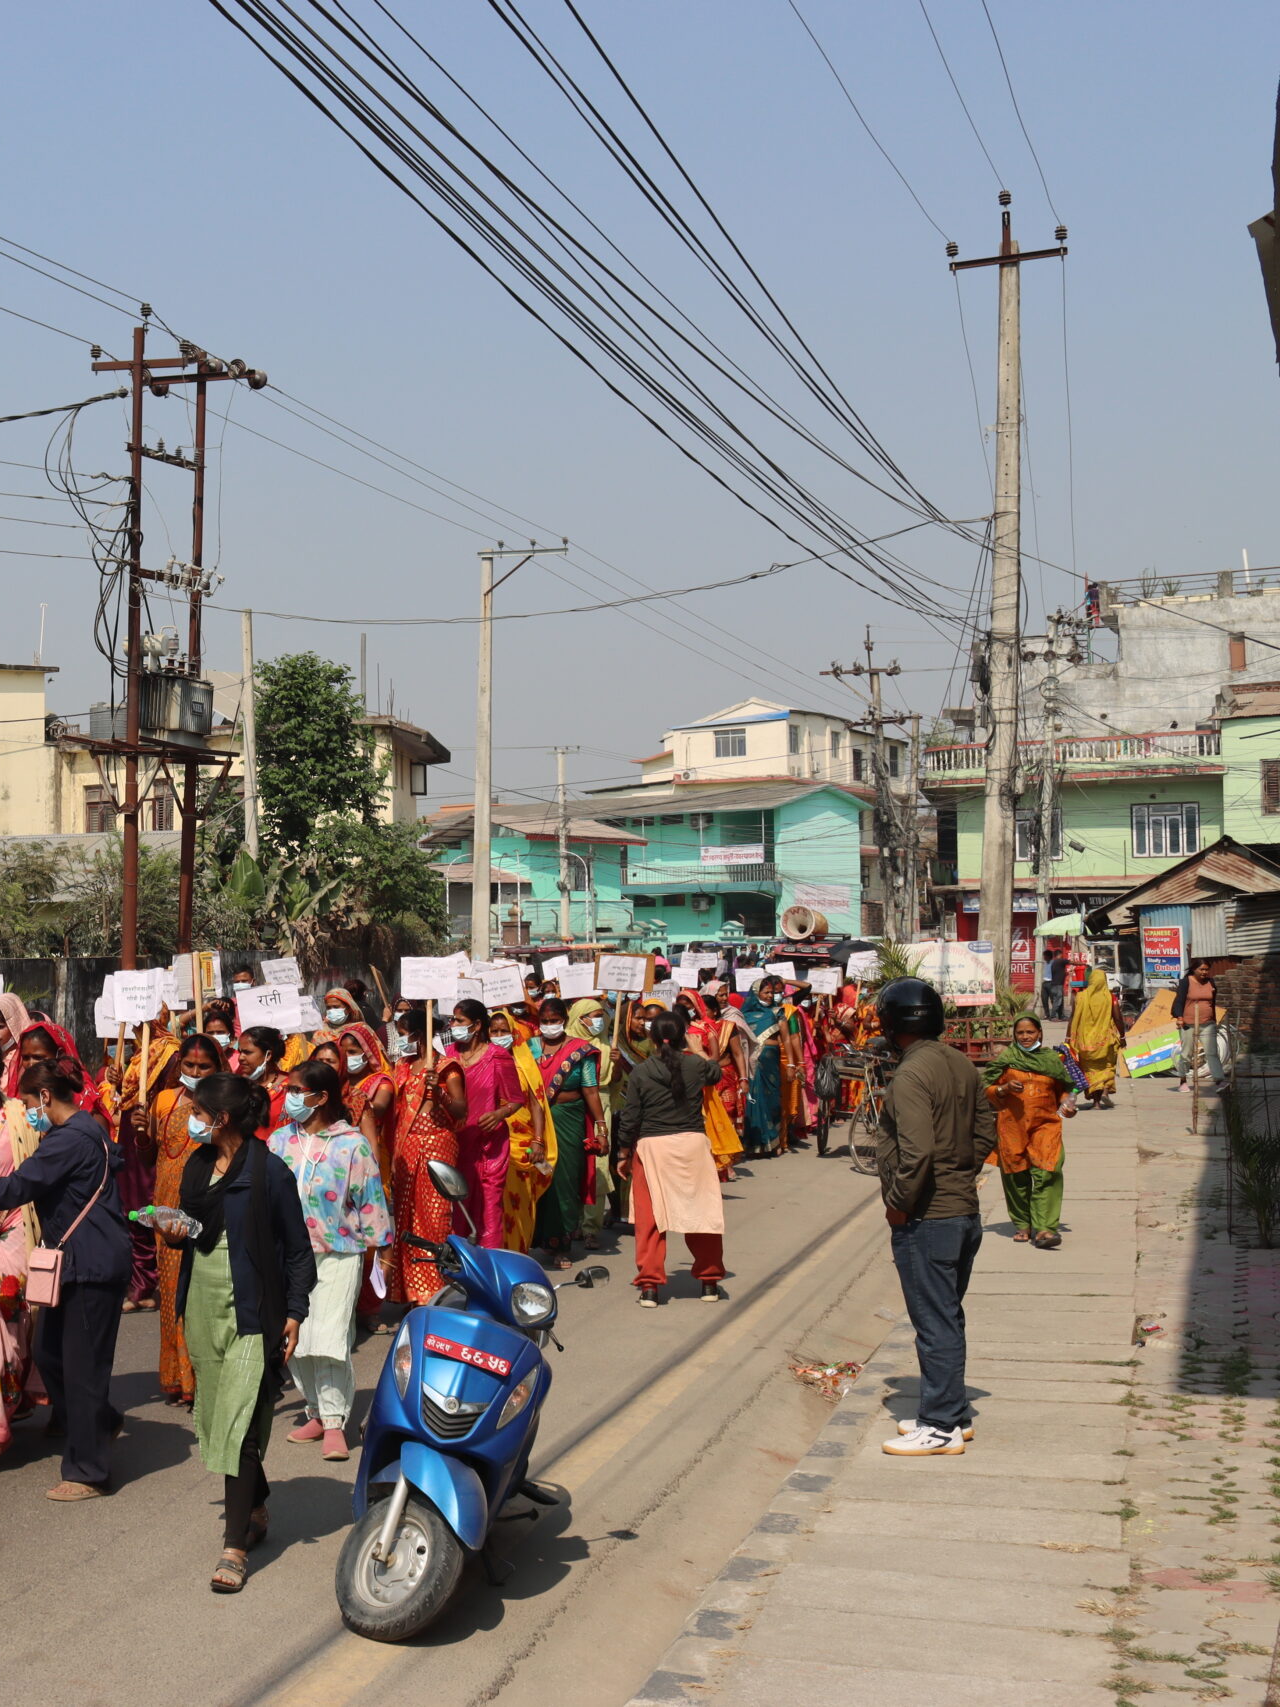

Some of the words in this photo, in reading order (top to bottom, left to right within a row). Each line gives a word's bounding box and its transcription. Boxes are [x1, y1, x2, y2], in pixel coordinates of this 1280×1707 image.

[1145, 947, 1161, 955] Work
[1162, 947, 1179, 955] VISA
[256, 989, 281, 1007] रानी
